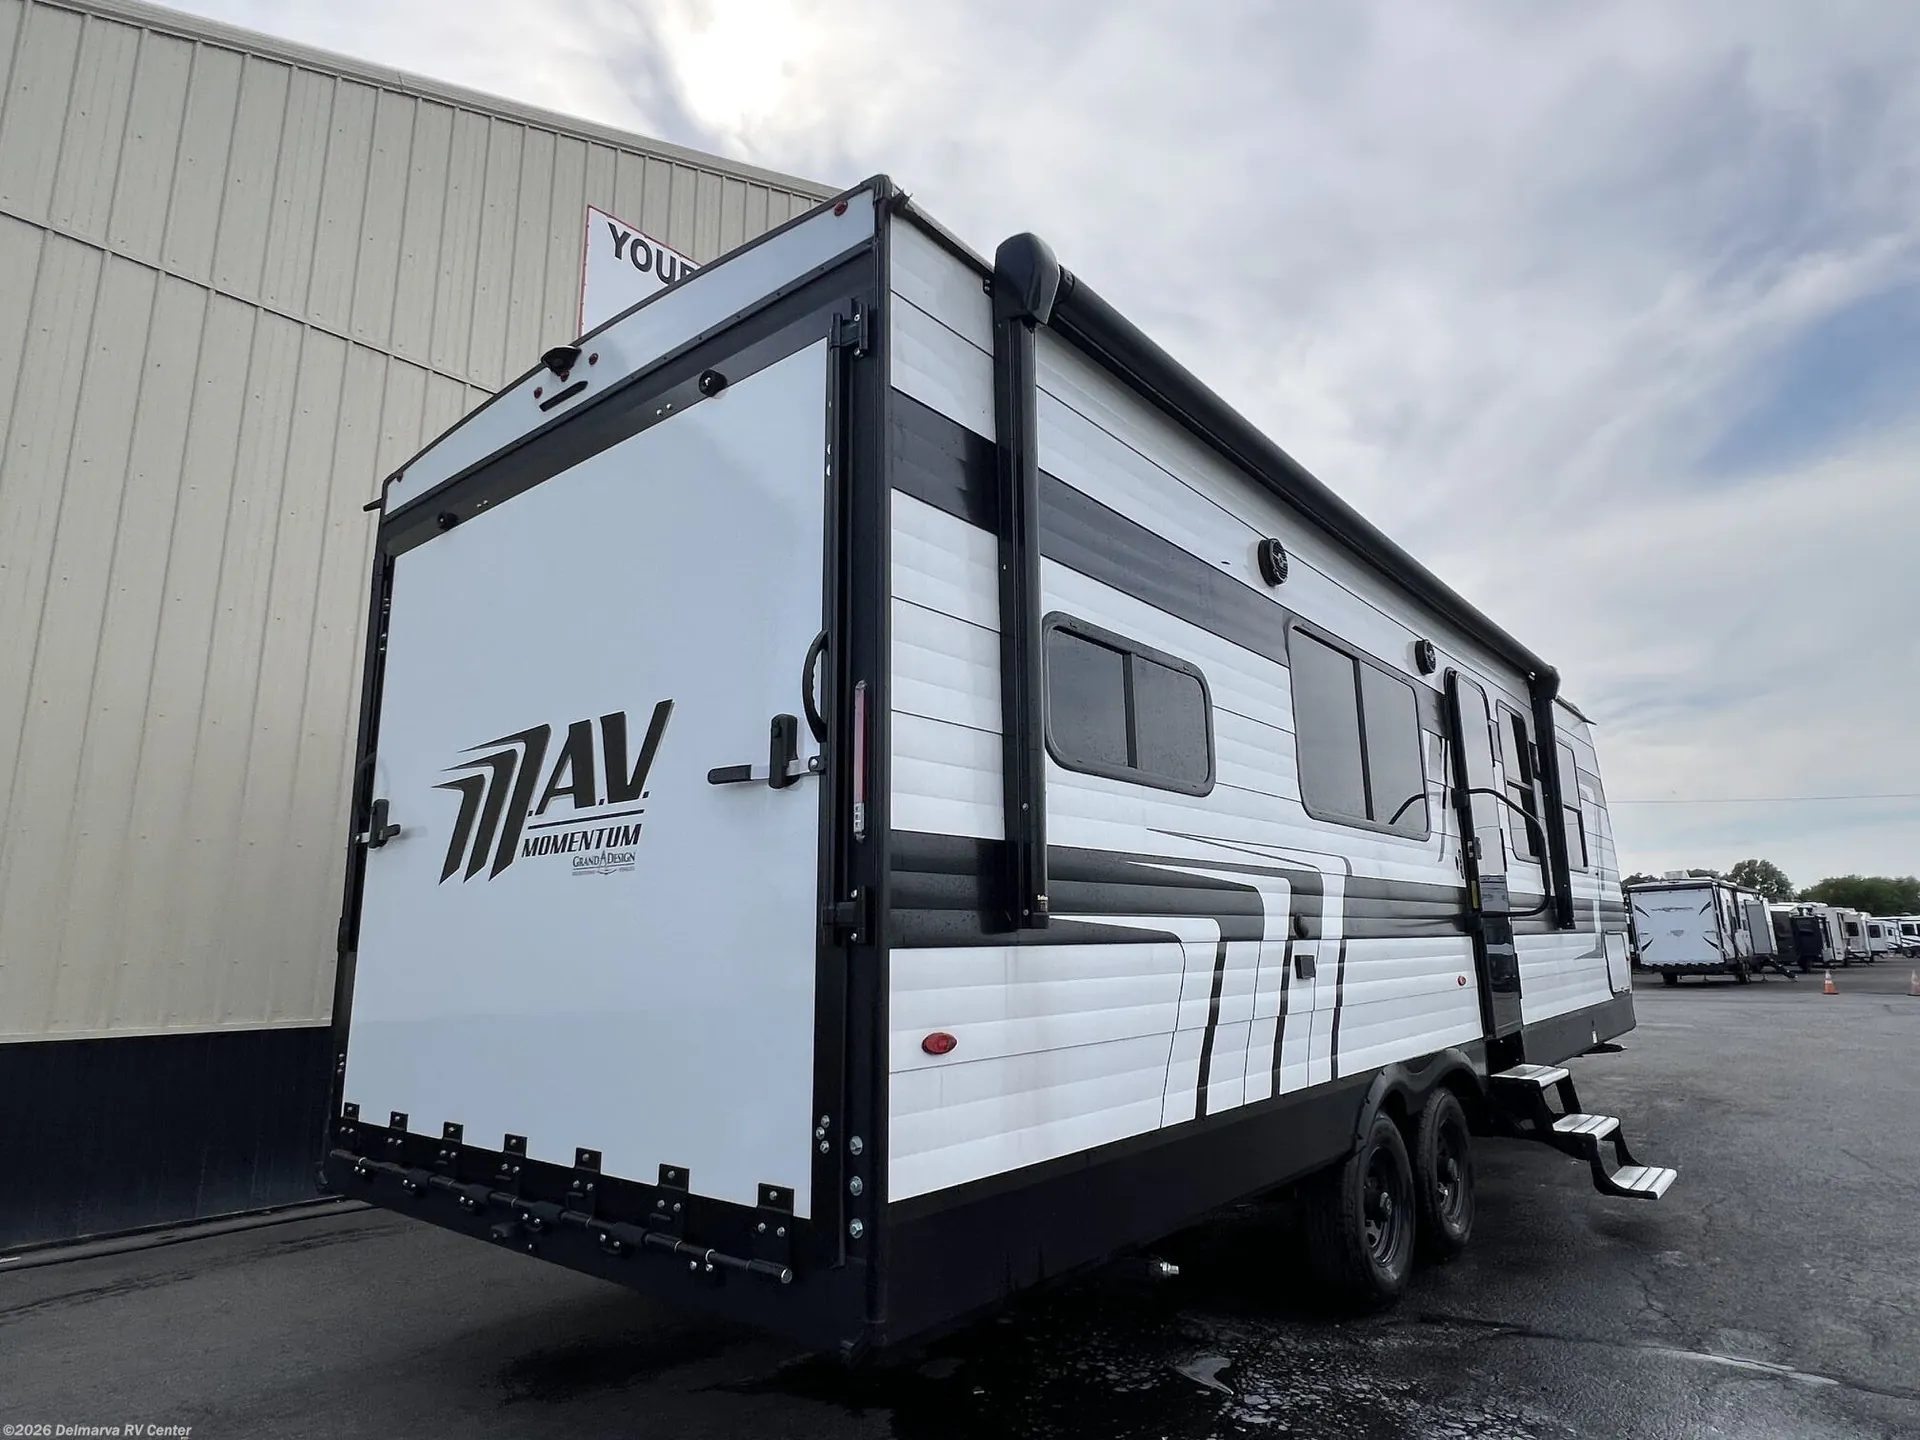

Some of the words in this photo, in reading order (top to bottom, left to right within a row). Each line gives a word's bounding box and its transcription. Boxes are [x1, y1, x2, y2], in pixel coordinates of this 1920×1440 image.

[521, 823, 642, 858] MOMENTUM
[572, 855, 600, 868] GRAND
[607, 852, 636, 864] DESIGN
